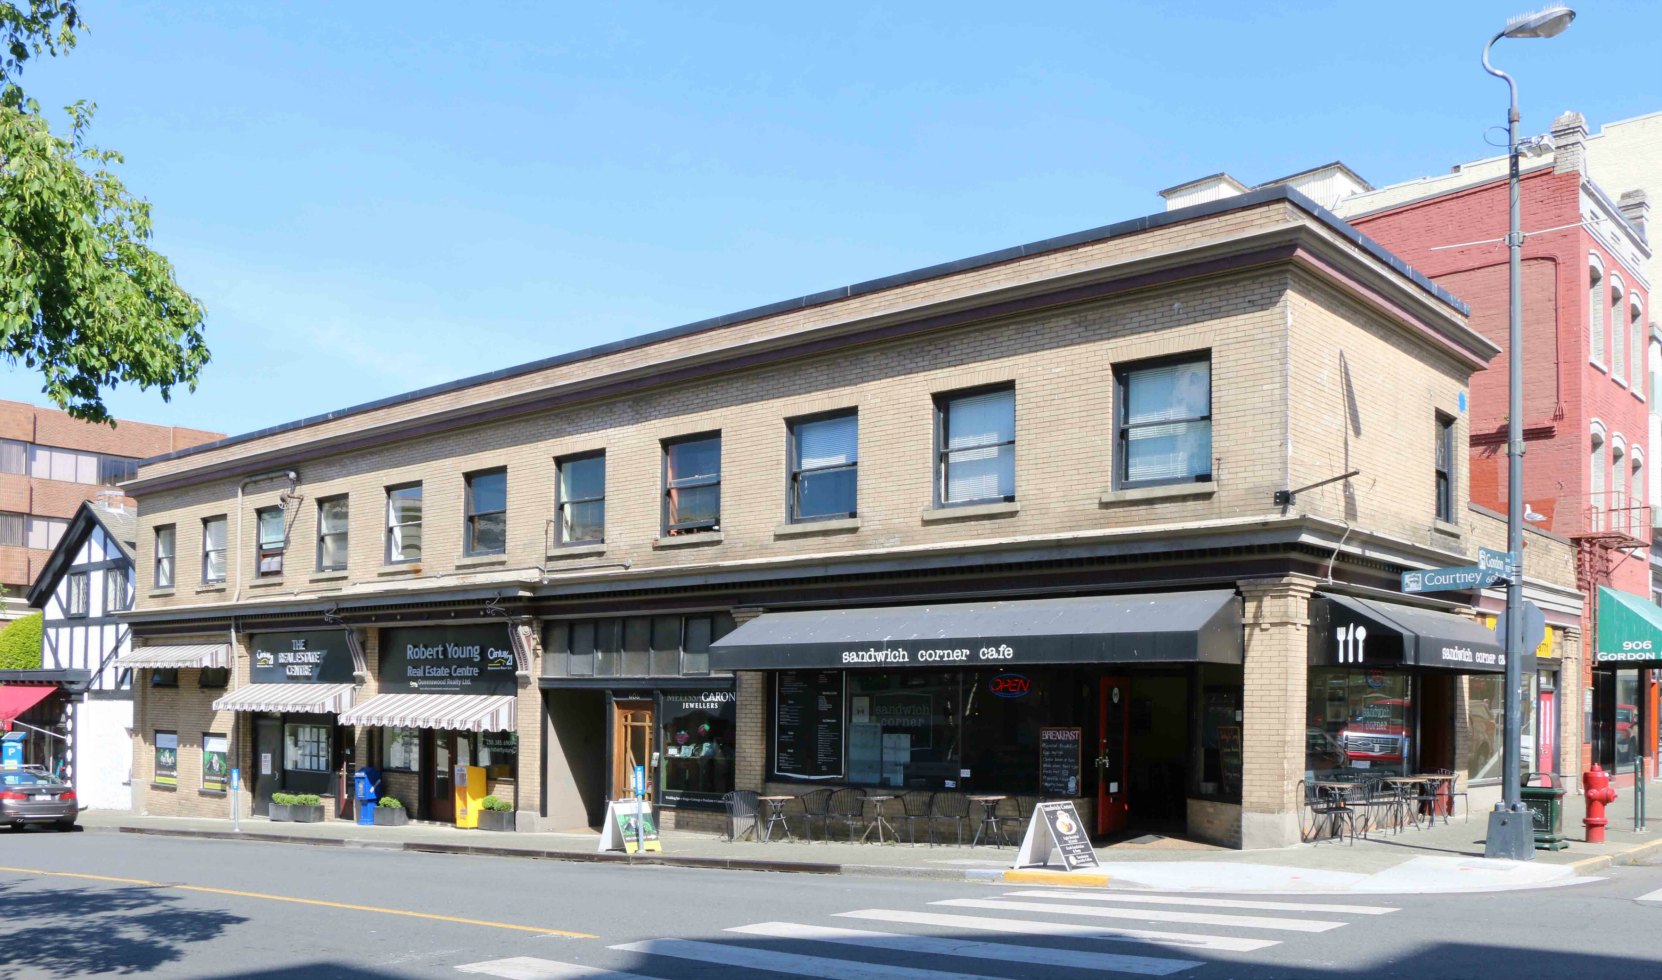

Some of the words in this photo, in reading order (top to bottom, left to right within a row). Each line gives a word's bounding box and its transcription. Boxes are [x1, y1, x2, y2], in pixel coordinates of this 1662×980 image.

[1486, 554, 1504, 571] Gordon
[1424, 572, 1482, 586] Courtney
[291, 640, 306, 650] THE
[1622, 640, 1653, 651] 906
[279, 653, 297, 663] REAL
[296, 652, 321, 663] ESTATE
[407, 644, 444, 660] Robert
[446, 643, 480, 662] Young
[842, 648, 909, 663] sandwich
[917, 648, 970, 662] corner
[979, 644, 1014, 660] cafe
[1442, 646, 1473, 663] sandwich
[1475, 651, 1497, 665] corner
[1498, 654, 1506, 665] ca
[1597, 651, 1656, 662] GORDON
[286, 664, 312, 676] CENTRE
[407, 665, 424, 677] Real
[425, 666, 450, 677] Estate
[451, 665, 479, 677] Centre
[991, 678, 1031, 692] OPEN
[701, 691, 736, 702] CARON
